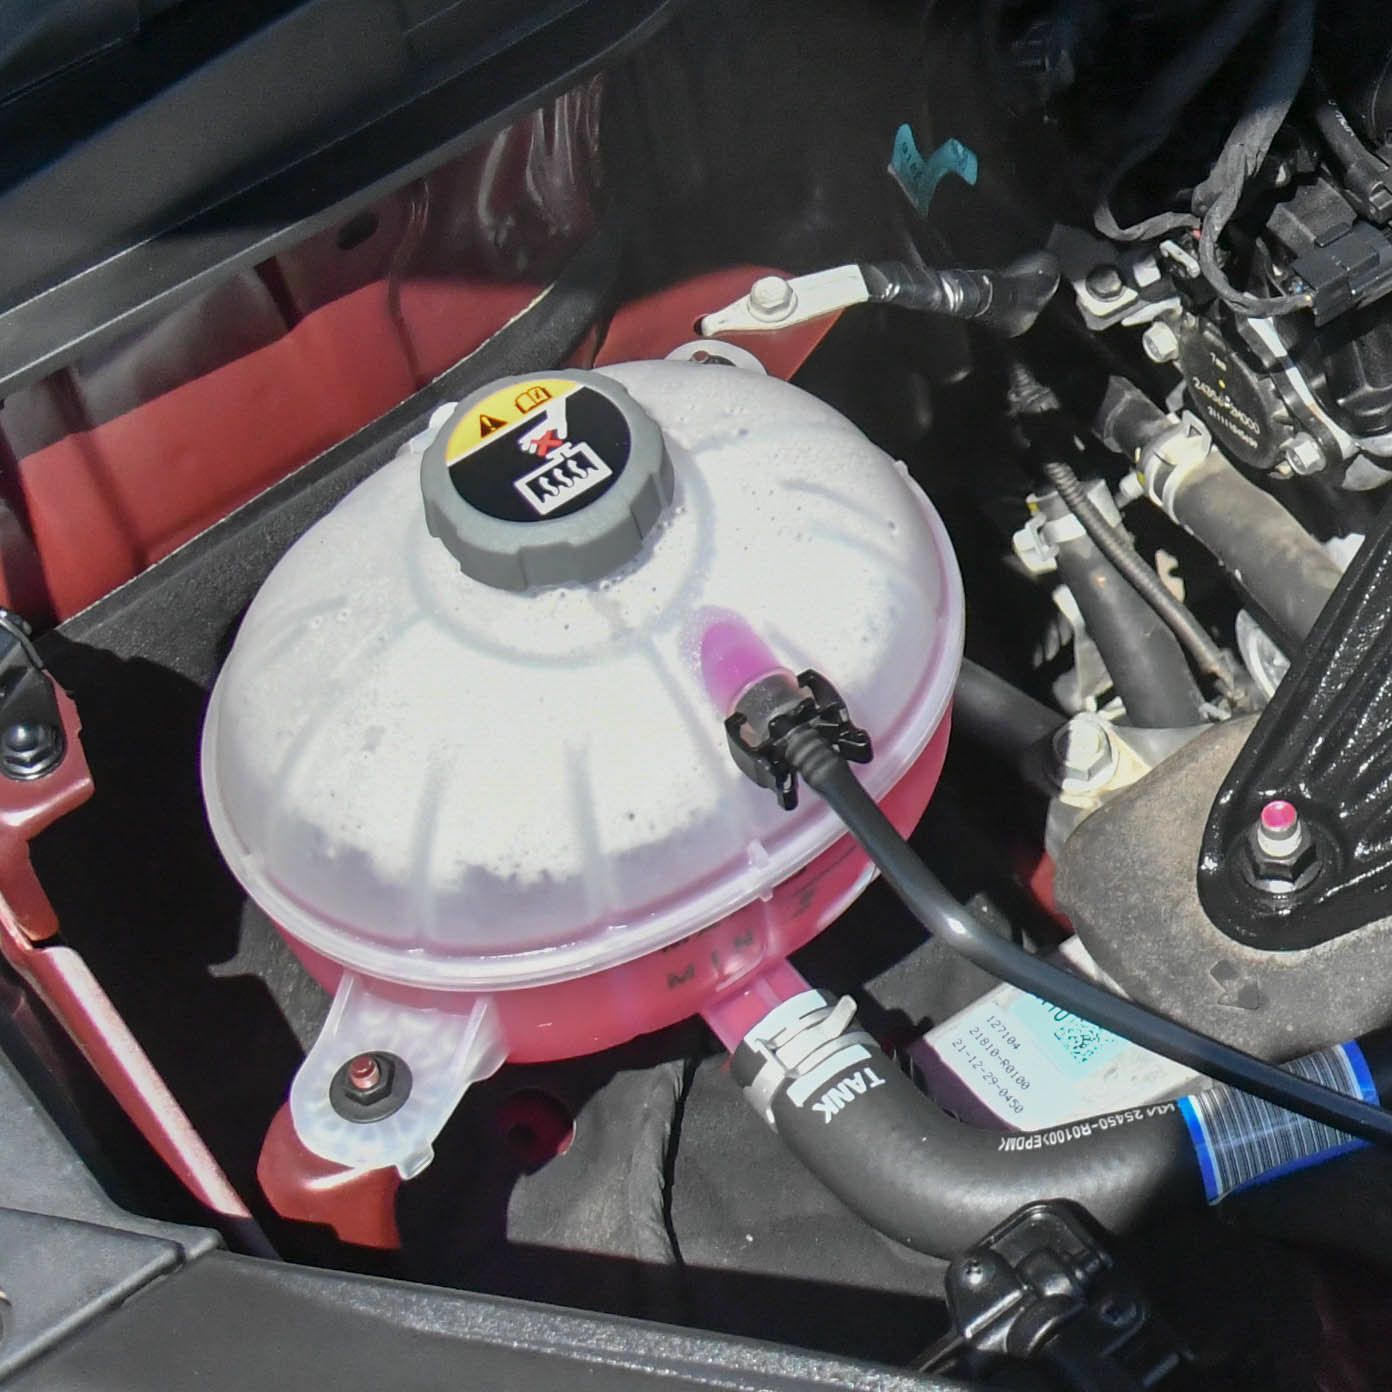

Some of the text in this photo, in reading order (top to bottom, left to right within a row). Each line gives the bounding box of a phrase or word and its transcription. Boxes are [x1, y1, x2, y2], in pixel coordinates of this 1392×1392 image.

[968, 1026, 1031, 1090] 21810-R0100
[985, 1015, 1022, 1050] 127104
[811, 1066, 886, 1124] TANK
[951, 1038, 1025, 1114] 21-12-29-0450
